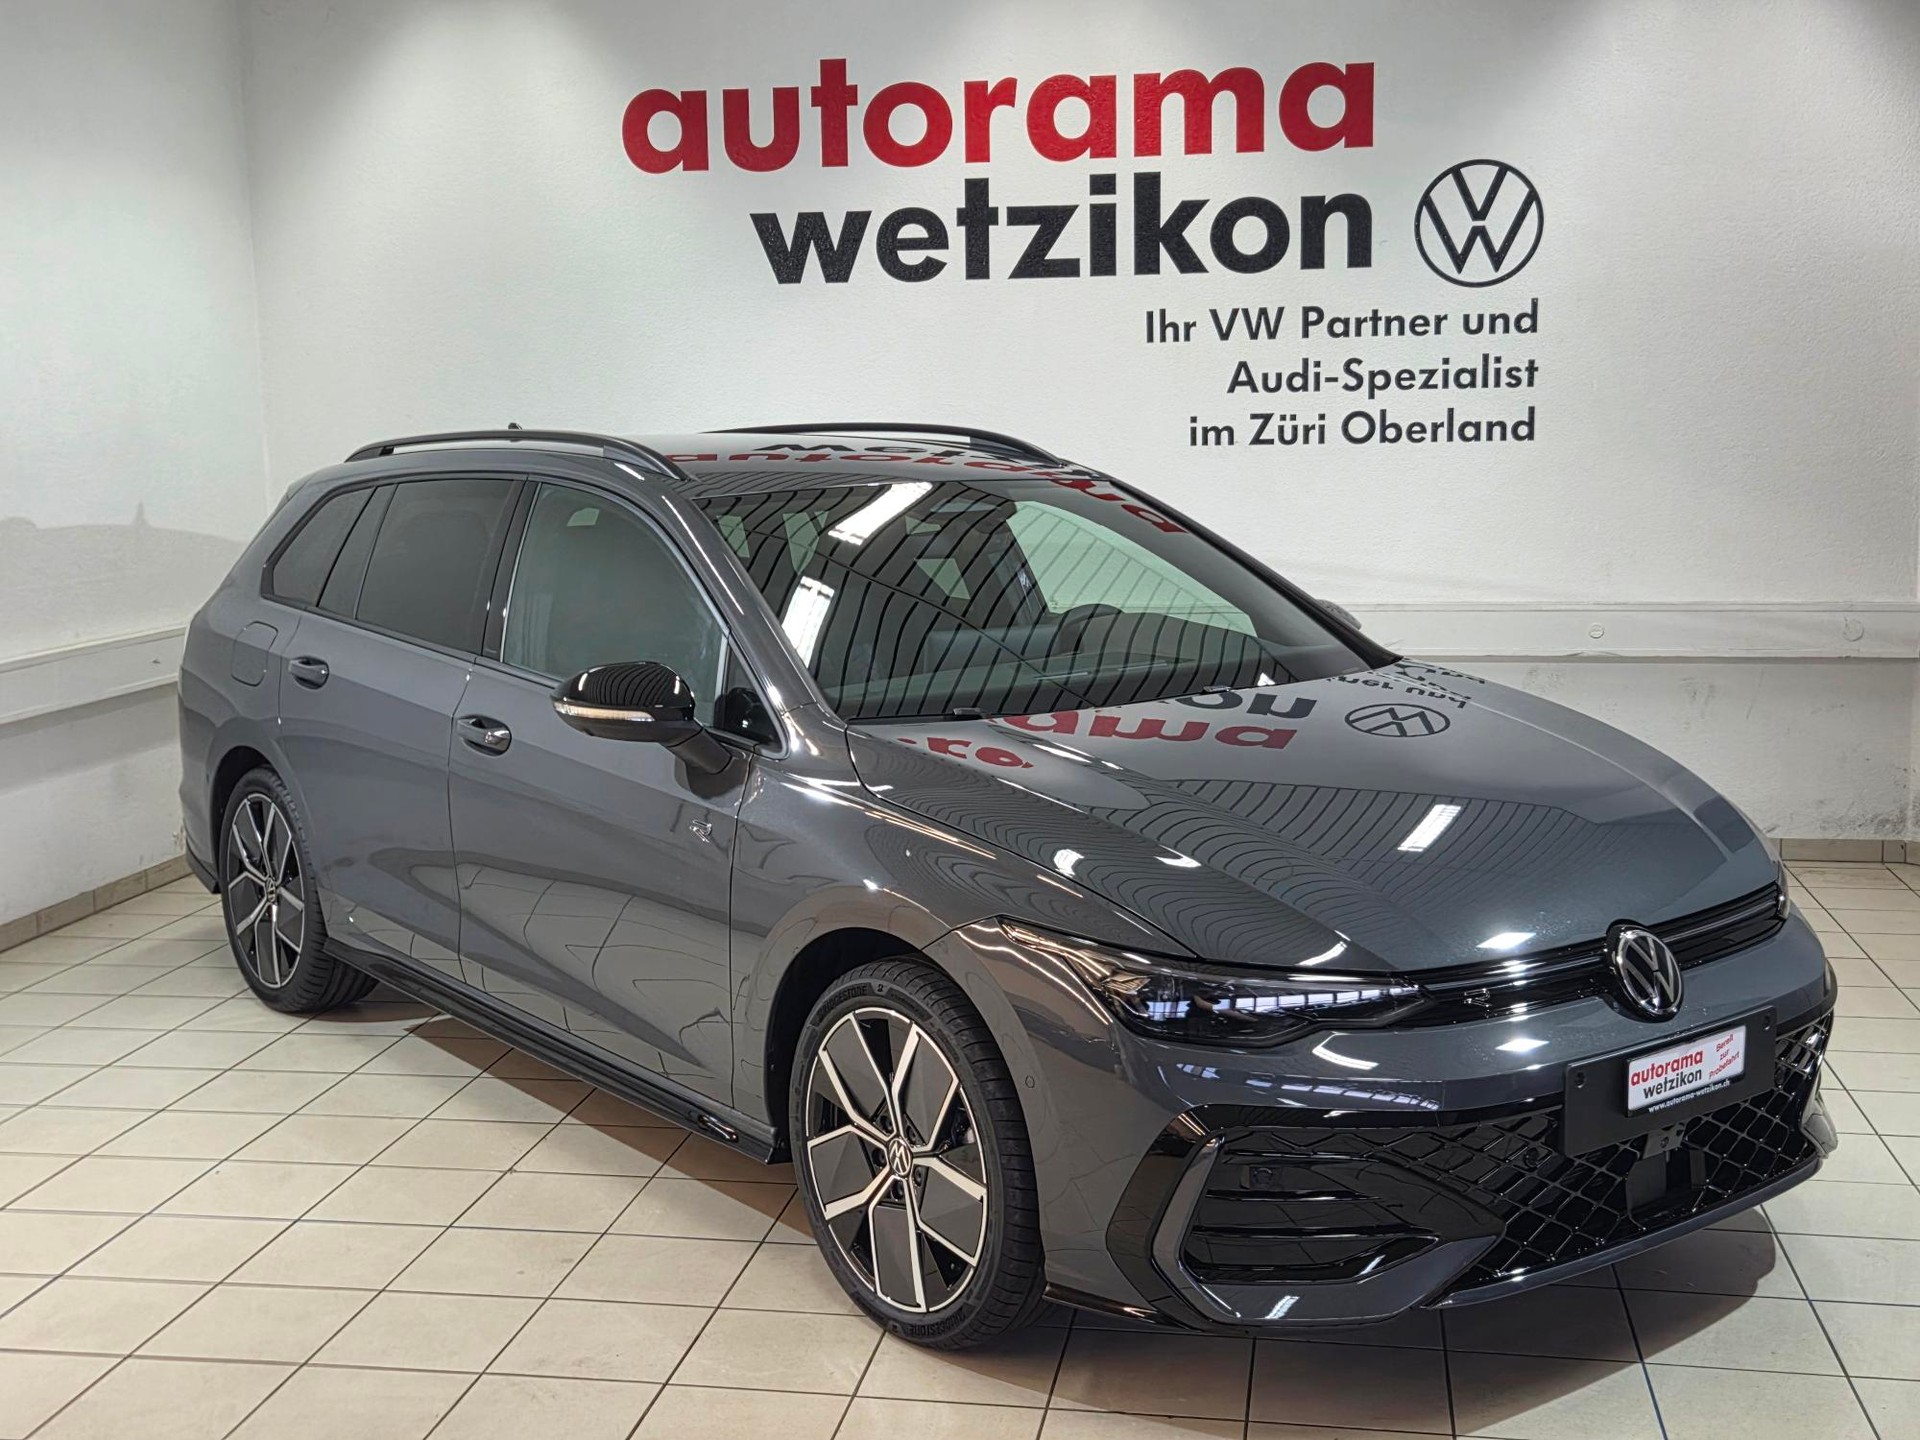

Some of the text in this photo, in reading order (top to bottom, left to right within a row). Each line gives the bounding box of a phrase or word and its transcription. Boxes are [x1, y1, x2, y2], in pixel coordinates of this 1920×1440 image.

[622, 59, 1374, 174] autorama
[749, 171, 1373, 285] wetzikon
[1146, 297, 1539, 344] Ihr VW Partner und
[1226, 353, 1539, 400] Audi-Spezialist
[1190, 405, 1536, 447] im Züri Oberland
[1630, 1050, 1704, 1087] autorama
[1643, 1069, 1702, 1099] wetzikon
[1647, 1079, 1731, 1113] www.autorama-wetzikon.ch
